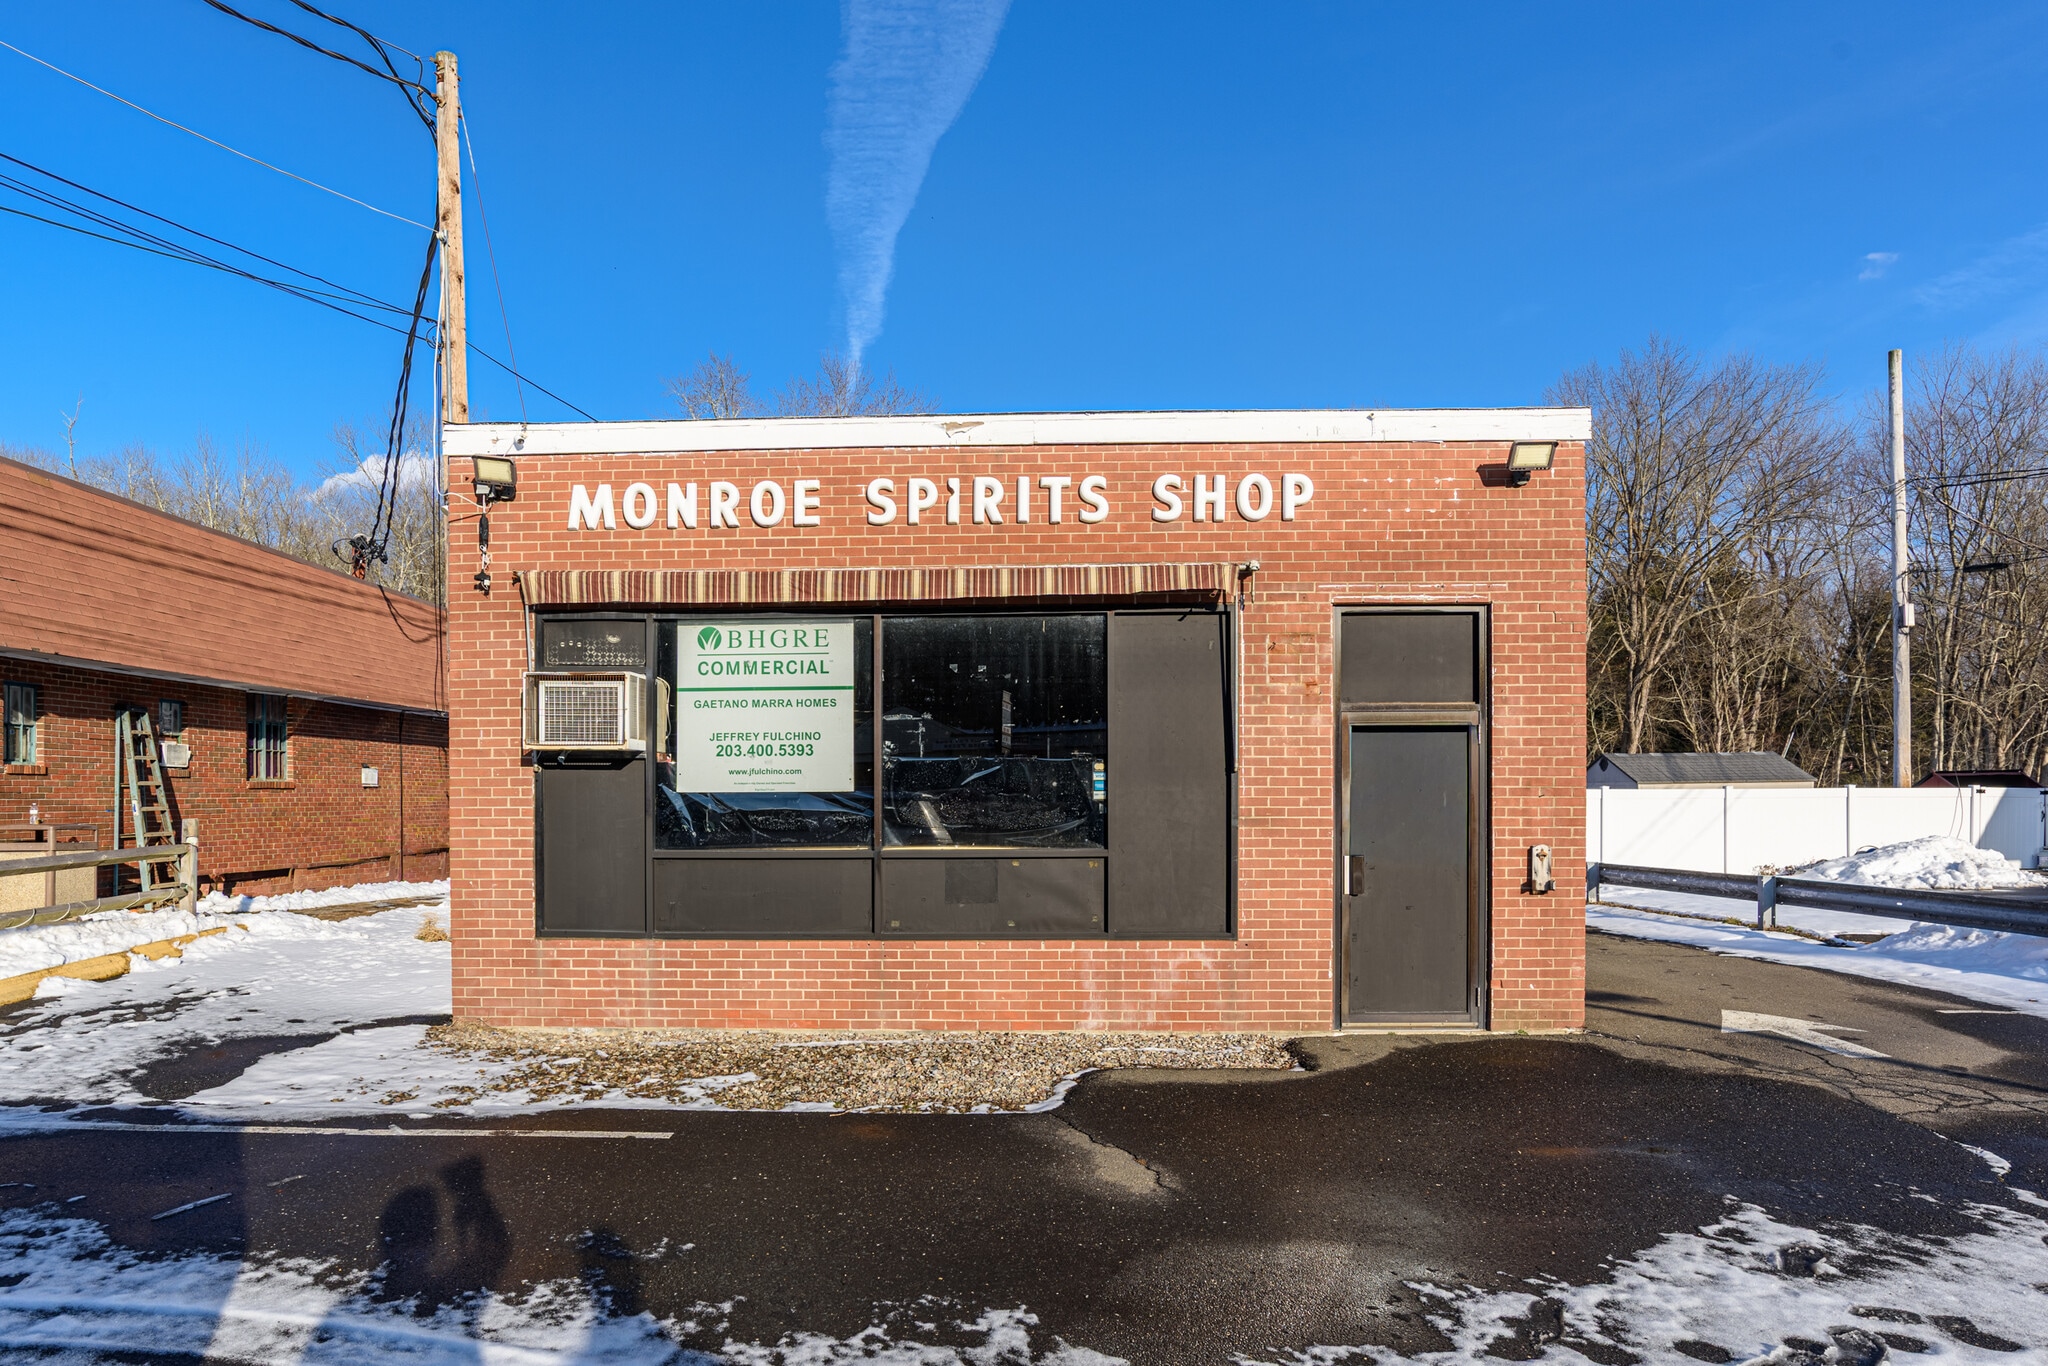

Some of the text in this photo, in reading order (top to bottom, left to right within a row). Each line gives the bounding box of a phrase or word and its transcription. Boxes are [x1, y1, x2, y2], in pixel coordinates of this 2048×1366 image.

[567, 473, 1314, 531] MONROE SPIRITS SHOP
[727, 629, 829, 648] BHGRE
[697, 660, 830, 676] COMMERCIAL
[694, 698, 837, 709] GAETANO MARRA HOMES
[709, 731, 821, 742] JEFFREY FULCHINO
[715, 744, 814, 757] 203.400.5393
[728, 768, 802, 776] www.jfulchino.com
